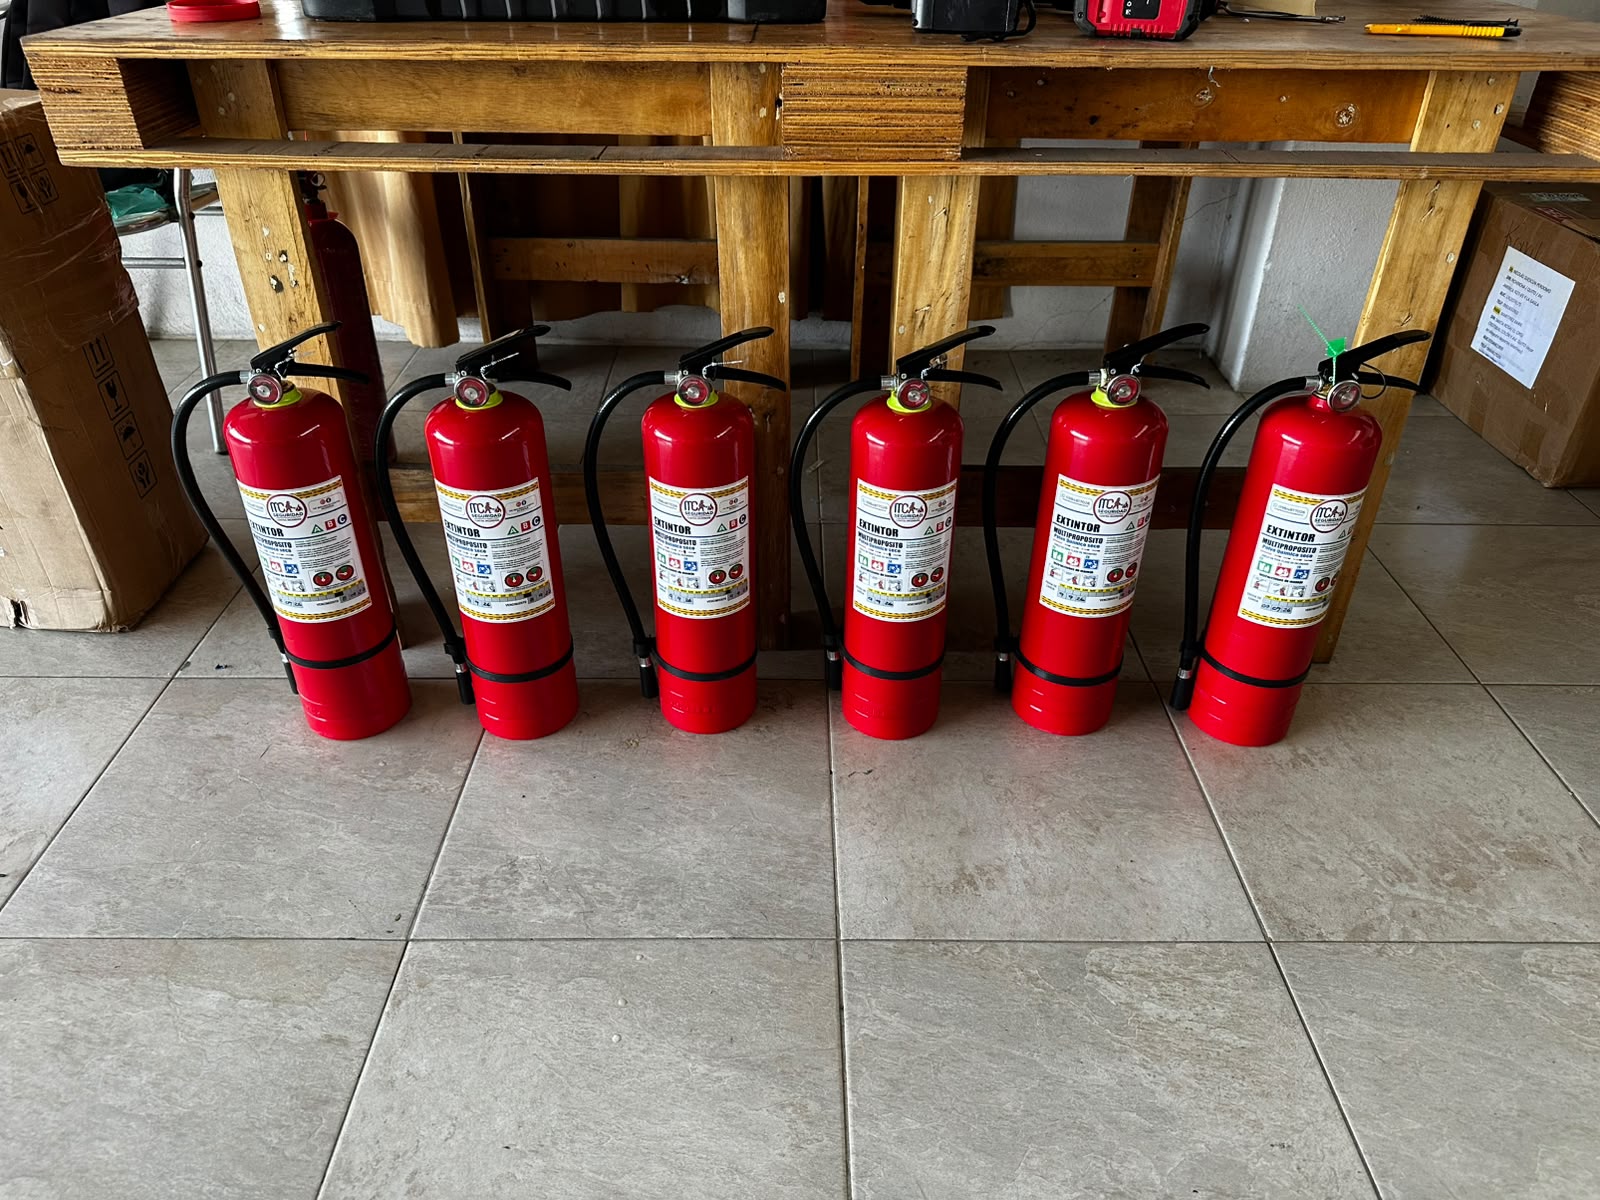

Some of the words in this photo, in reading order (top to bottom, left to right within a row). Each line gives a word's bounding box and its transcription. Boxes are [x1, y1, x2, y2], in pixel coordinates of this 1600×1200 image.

[444, 519, 480, 538] EXTINTOR
[654, 516, 692, 535] EXTINTOR
[859, 518, 899, 538] EXTINTOR
[1056, 514, 1100, 533] EXTINTOR
[858, 532, 904, 548] MULTIPROPOSITO
[1054, 527, 1103, 544] MULTIPROPOSITO
[1266, 524, 1316, 542] EXTINTOR
[1262, 538, 1317, 554] MULTIPROPOSITO
